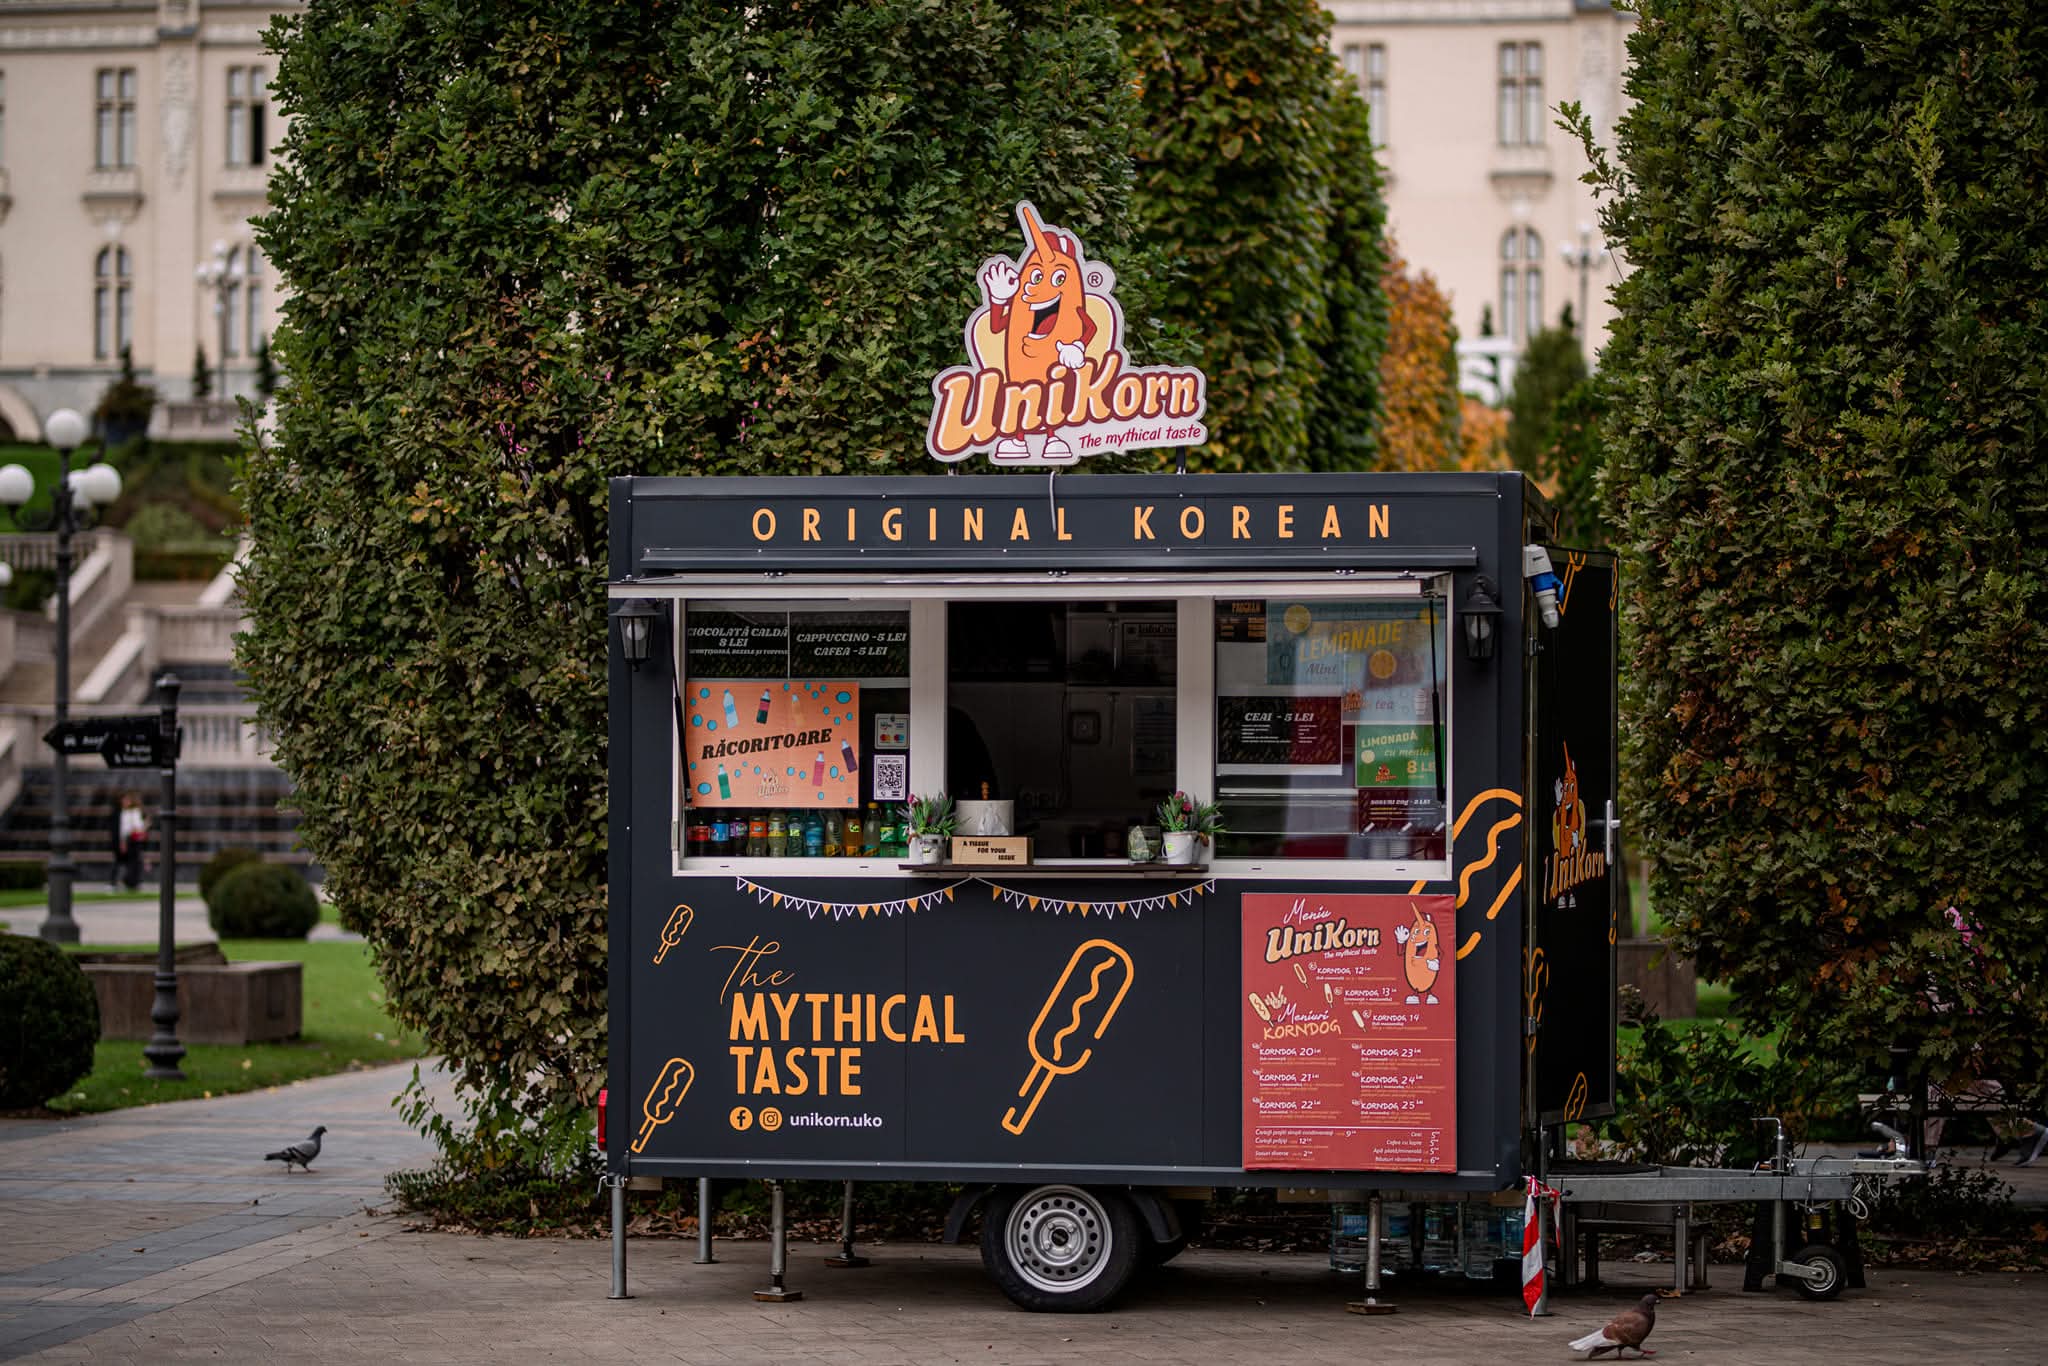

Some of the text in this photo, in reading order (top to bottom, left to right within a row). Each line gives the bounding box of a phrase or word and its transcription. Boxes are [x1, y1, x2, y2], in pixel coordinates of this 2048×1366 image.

[934, 353, 1200, 453] UniKorn
[1079, 424, 1201, 449] The mythical taste
[752, 504, 1390, 541] ORIGINAL KOREAN
[728, 637, 749, 647] LEI
[796, 632, 870, 642] CAPPUCCINO
[886, 632, 908, 642] LEI
[1299, 620, 1404, 663] LEMONADE
[814, 646, 851, 656] CAFEA
[867, 646, 889, 656] LEI
[1244, 712, 1272, 722] CEAI
[1293, 712, 1315, 722] LEI
[701, 728, 832, 760] RĂCORITOARE
[1407, 759, 1418, 774] 8
[1544, 837, 1605, 905] UniKorn
[1283, 898, 1332, 925] Meniu
[1265, 918, 1381, 963] UniKorn
[1324, 948, 1378, 959] The mythical taste
[1317, 967, 1351, 975] KORNDOG
[1344, 989, 1379, 997] KORNDOG
[1382, 987, 1390, 996] 13
[729, 992, 966, 1043] MYTHICAL
[1277, 1002, 1329, 1023] Meniuri
[1373, 1014, 1407, 1022] KORNDOG
[1263, 1019, 1342, 1040] KORNDOG
[1260, 1048, 1297, 1056] KORNDOG
[1299, 1047, 1314, 1056] 20
[1361, 1048, 1399, 1057] KORNDOG
[1401, 1048, 1413, 1057] 23
[729, 1046, 862, 1096] TASTE
[1260, 1073, 1297, 1082] KORNDOG
[1300, 1073, 1311, 1082] 21
[1360, 1076, 1398, 1084] KORNDOG
[1401, 1076, 1415, 1085] 24
[1260, 1101, 1297, 1110] KORNDOG
[1301, 1100, 1313, 1109] 22
[1361, 1102, 1399, 1111] KORNDOG
[1401, 1100, 1415, 1110] 25
[790, 1112, 883, 1127] unikorn.uko
